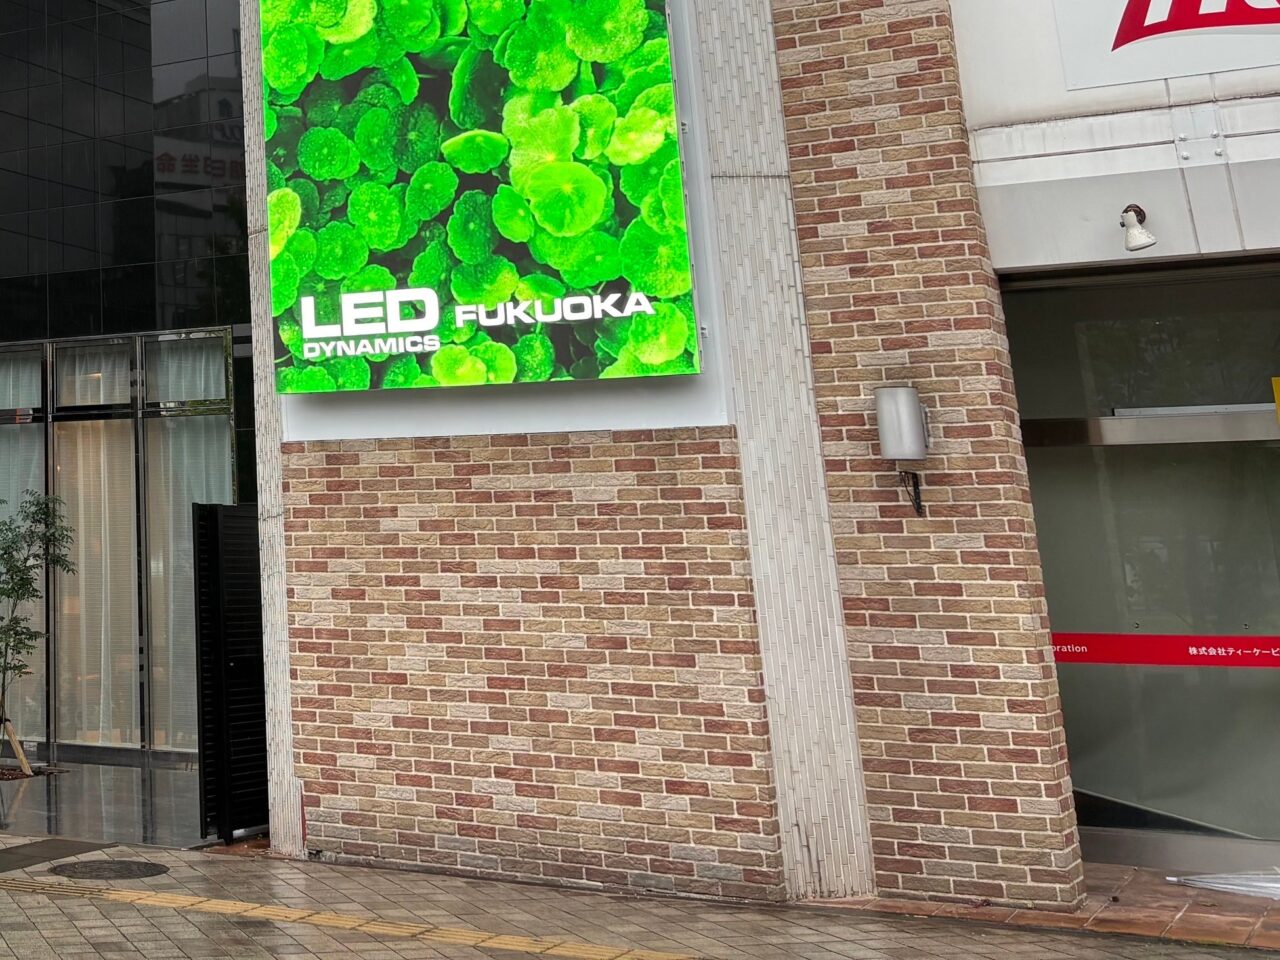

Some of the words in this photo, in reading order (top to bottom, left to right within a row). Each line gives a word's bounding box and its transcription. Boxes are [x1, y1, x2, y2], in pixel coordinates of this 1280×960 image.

[301, 288, 439, 338] LED
[455, 292, 655, 327] FUKUOKA
[303, 334, 441, 358] DYNAMICS
